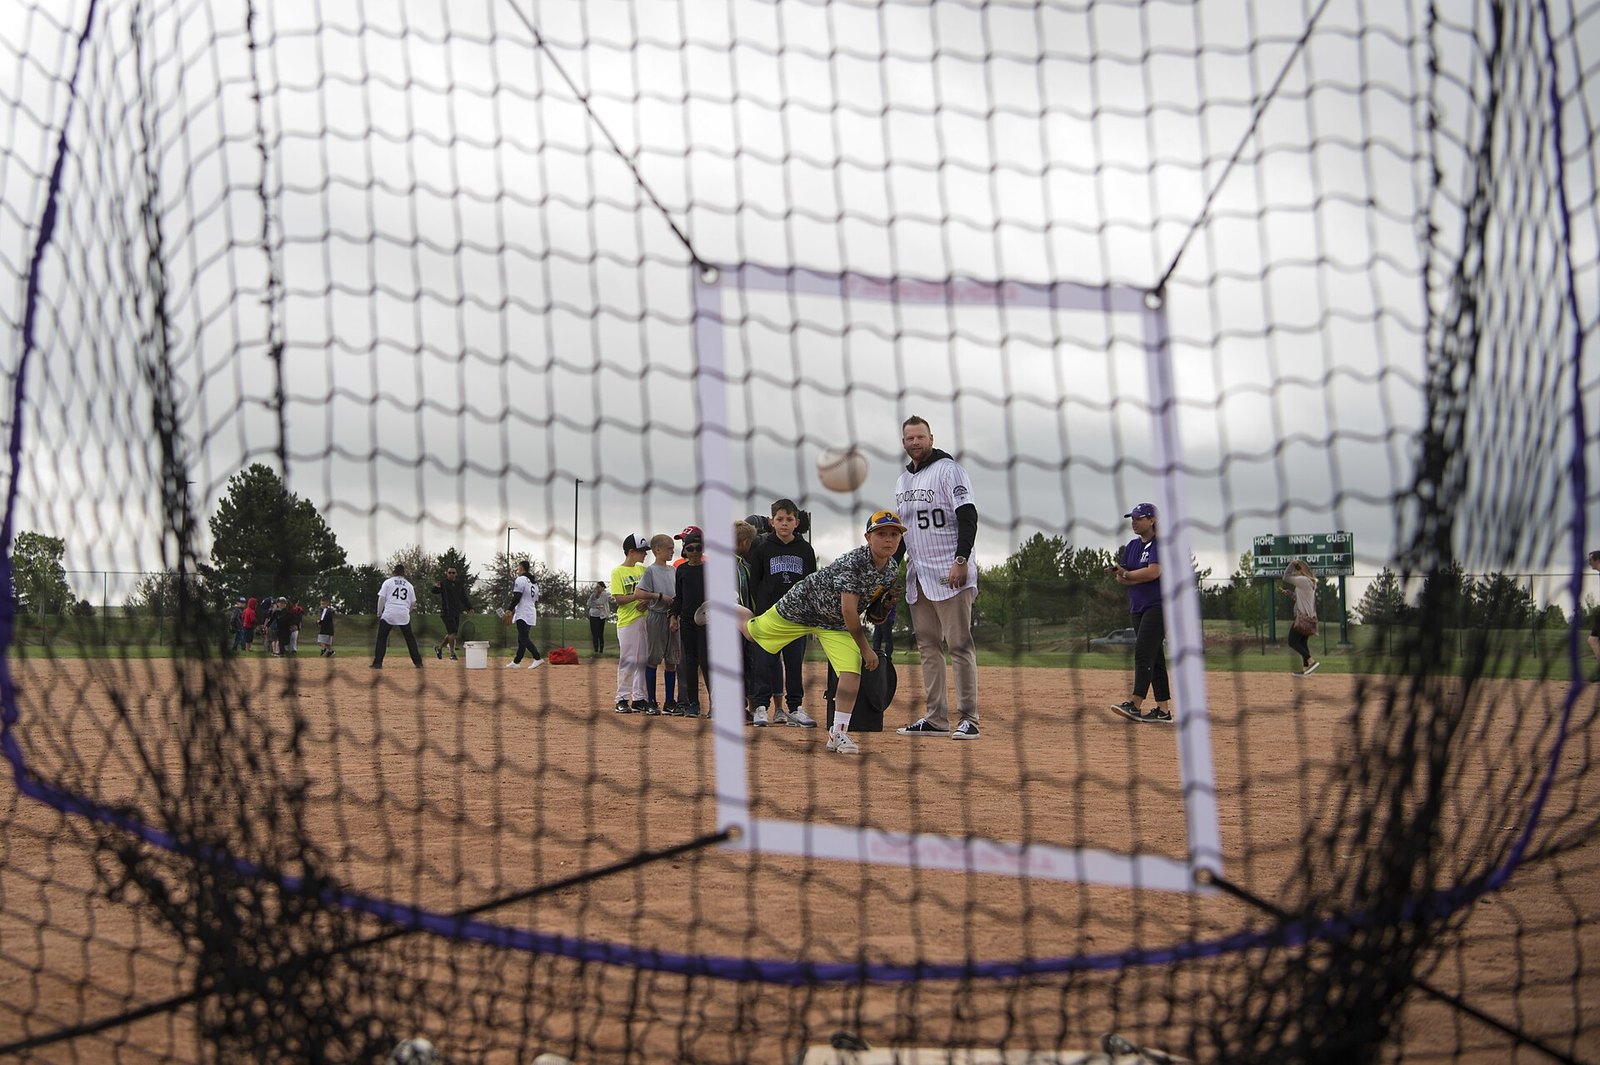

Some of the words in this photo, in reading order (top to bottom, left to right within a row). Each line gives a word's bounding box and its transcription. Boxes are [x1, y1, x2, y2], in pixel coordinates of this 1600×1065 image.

[917, 508, 946, 530] 50
[1254, 536, 1275, 546] HOME
[1288, 535, 1314, 545] INNING
[1326, 533, 1351, 543] GUEST
[1258, 556, 1273, 564] BALL
[1306, 554, 1320, 563] OUT
[392, 587, 408, 600] 43
[531, 586, 536, 598] 6
